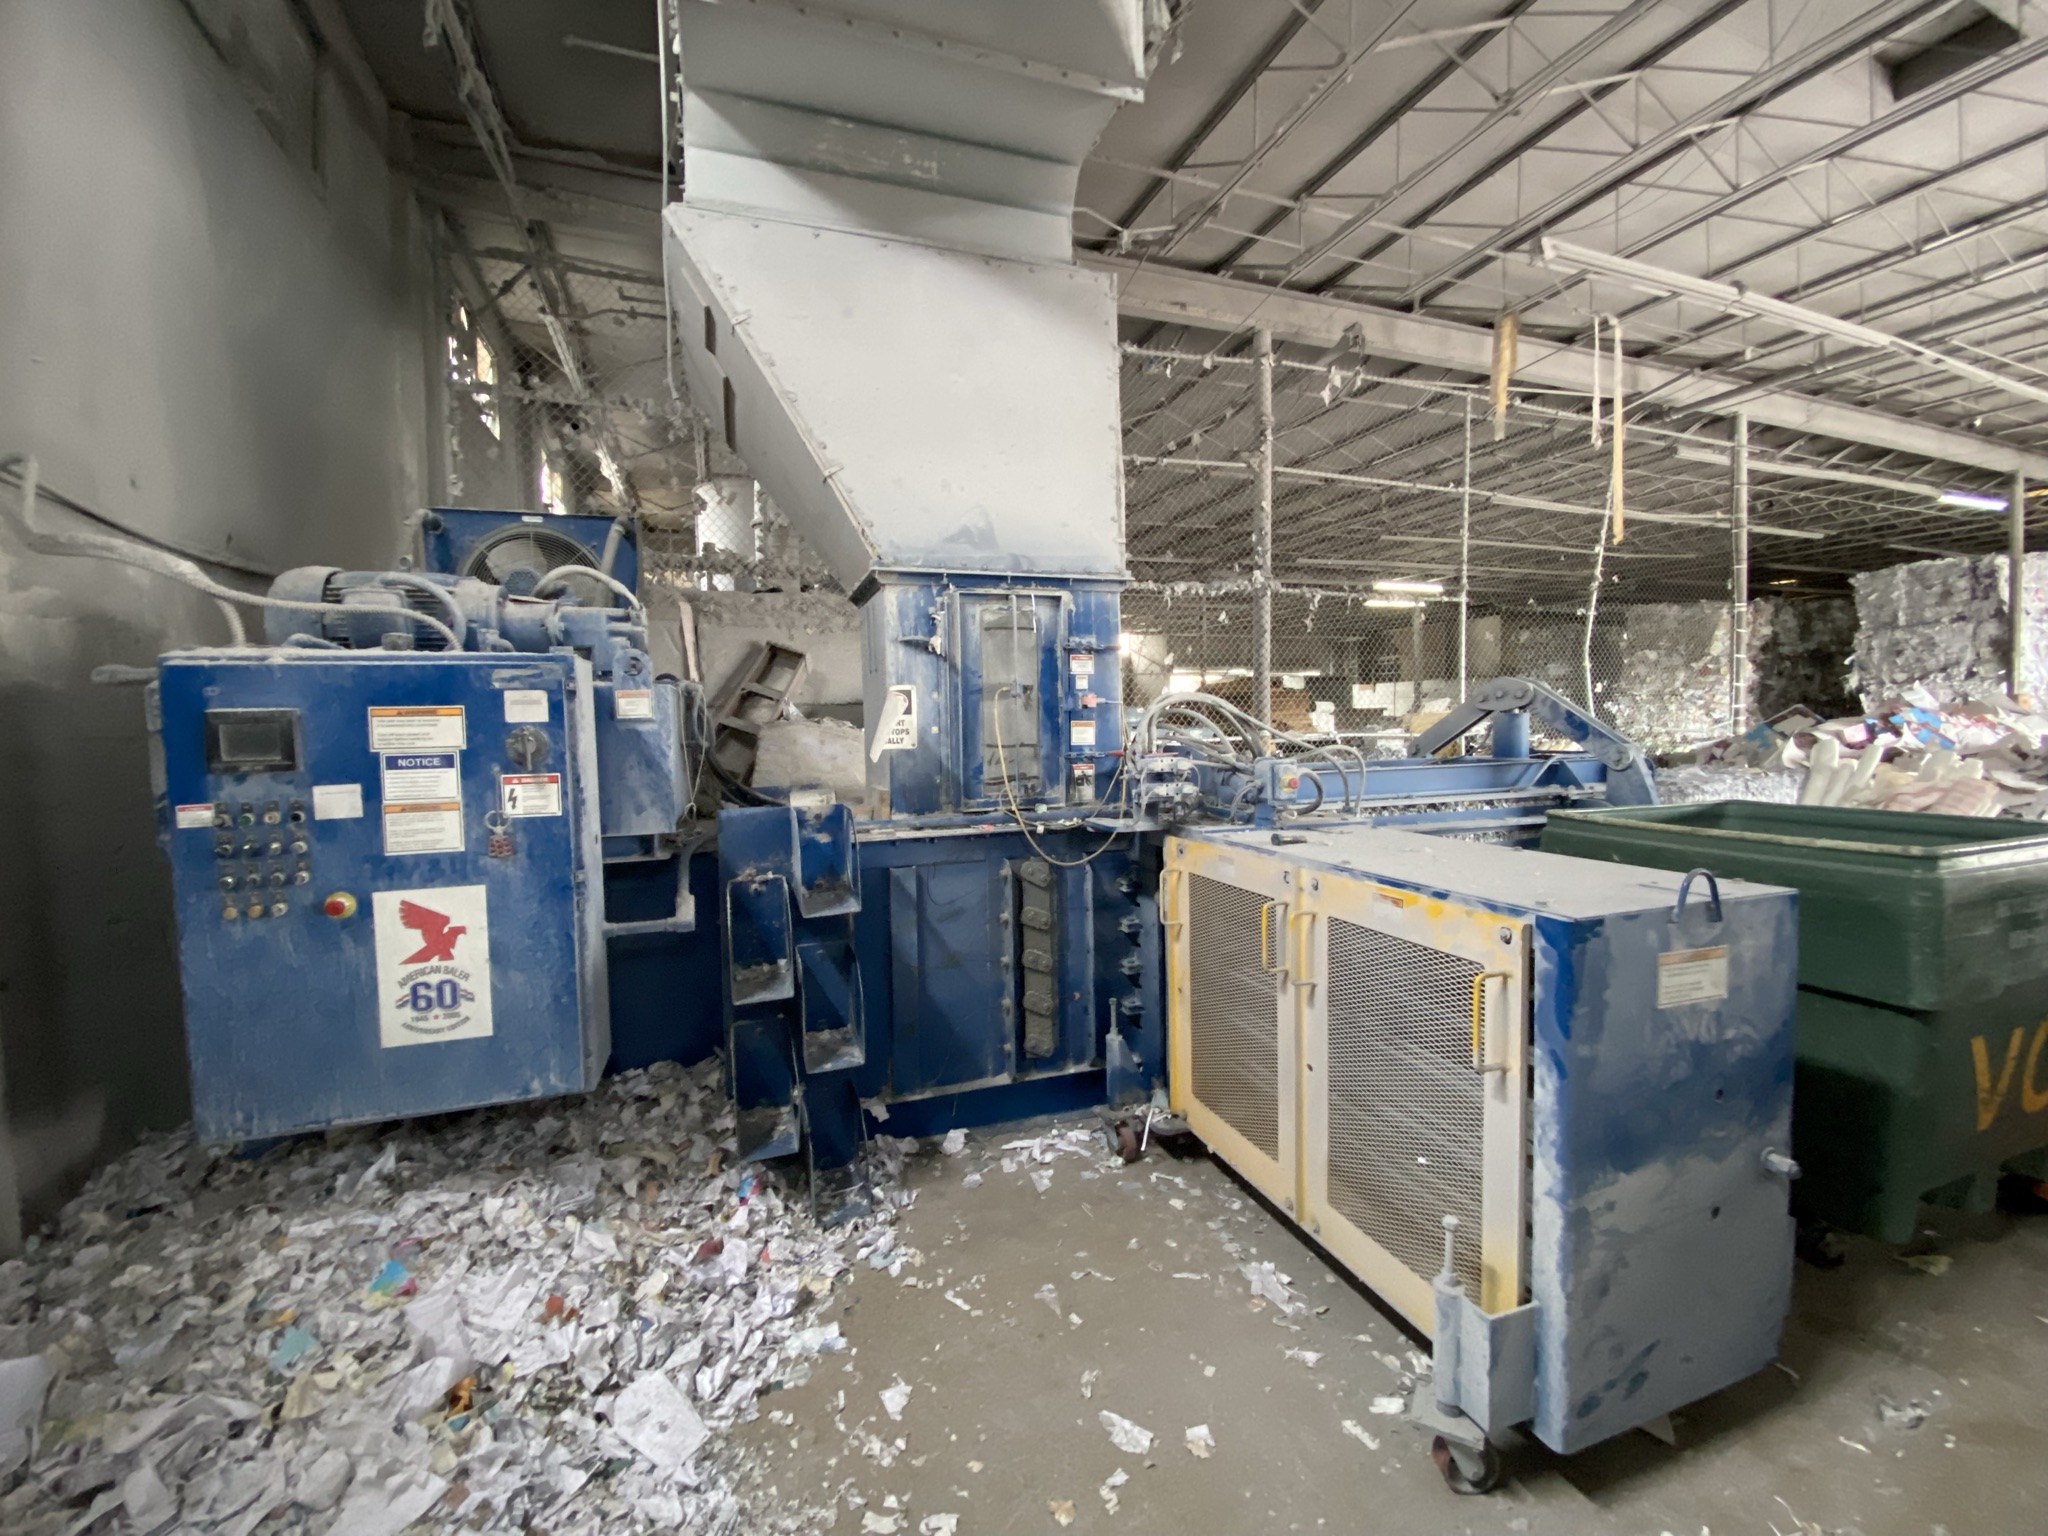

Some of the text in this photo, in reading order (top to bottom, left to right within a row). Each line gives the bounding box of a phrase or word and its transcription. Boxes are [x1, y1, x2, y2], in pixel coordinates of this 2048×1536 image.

[397, 757, 442, 768] NOTICE
[398, 966, 470, 988] AMERICAN BALER
[410, 979, 461, 1013] 60
